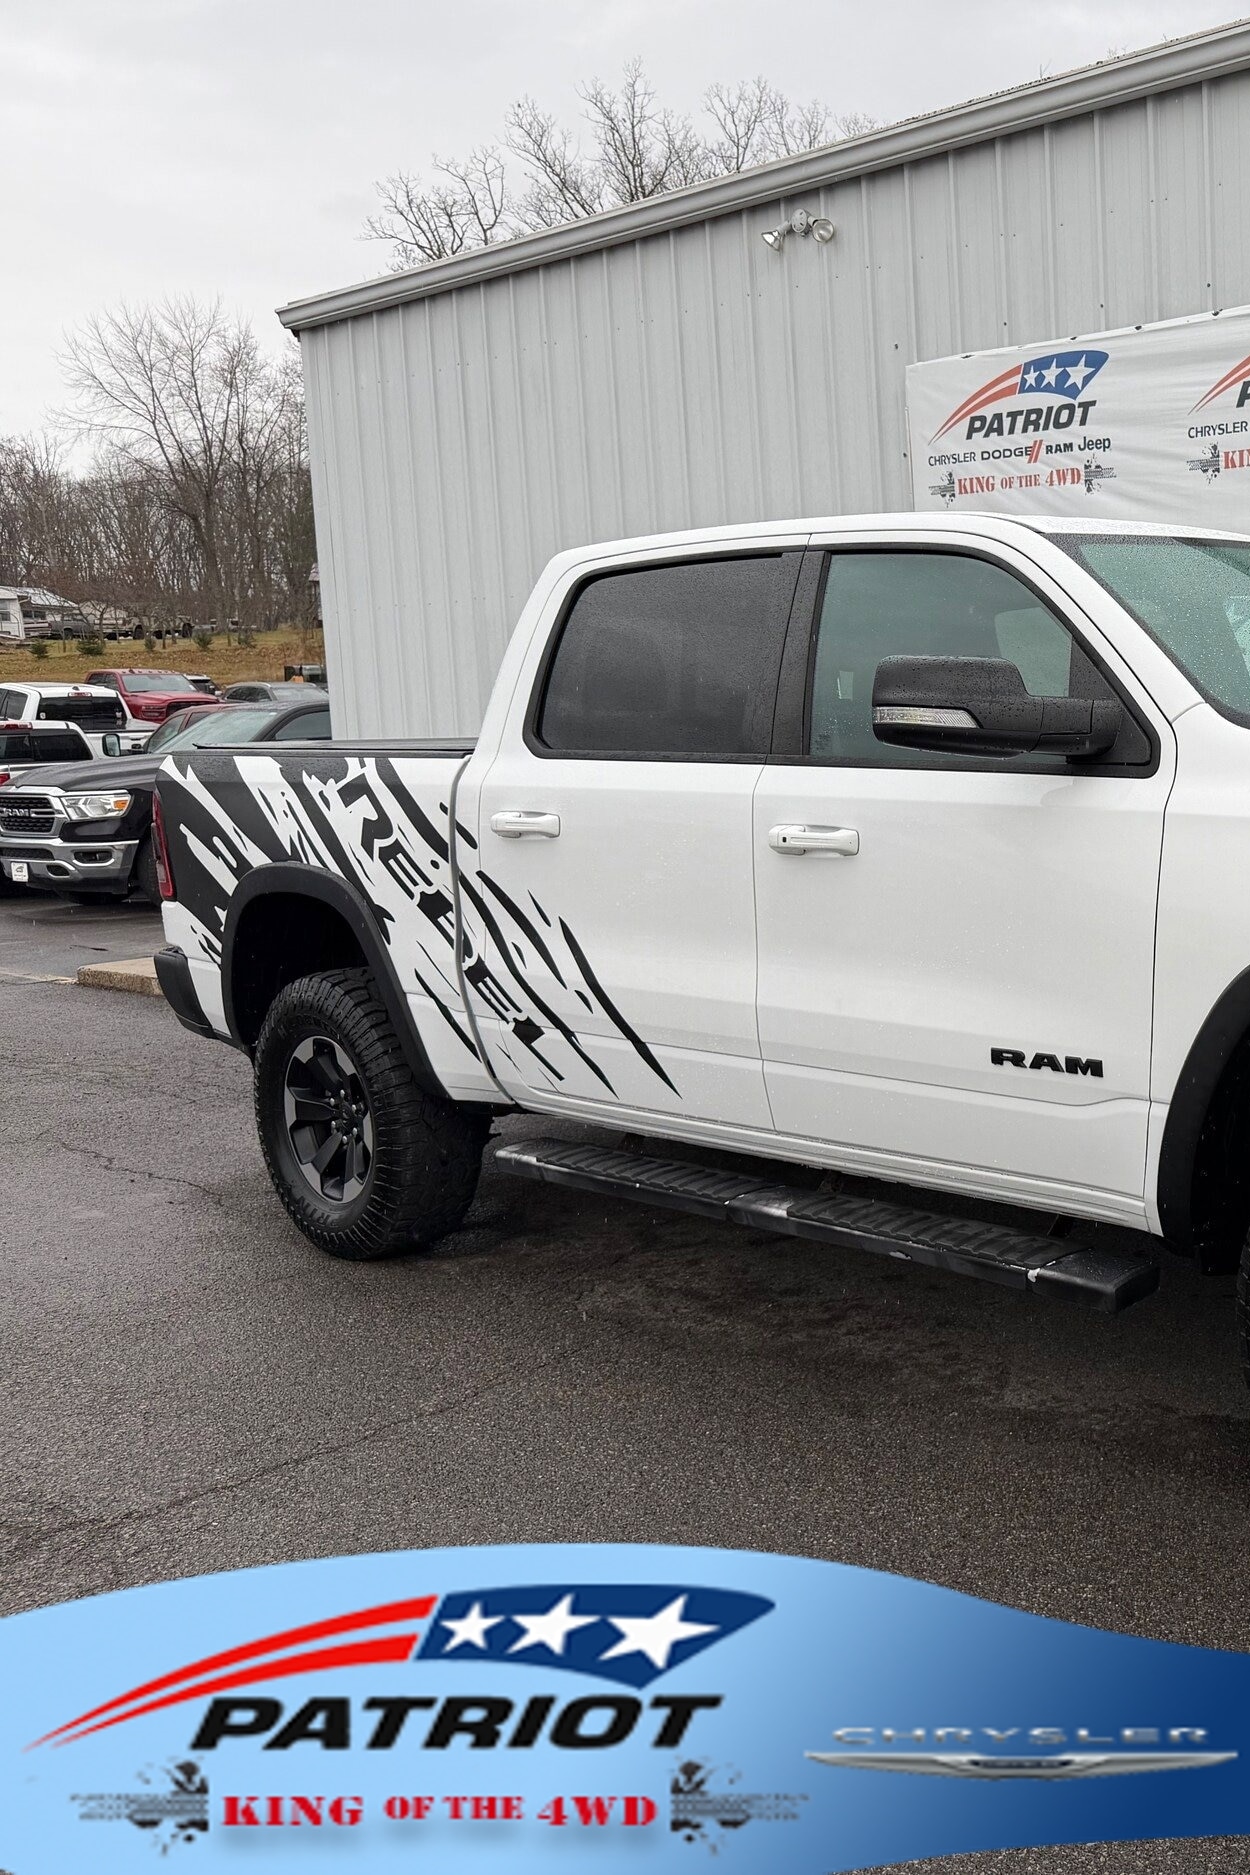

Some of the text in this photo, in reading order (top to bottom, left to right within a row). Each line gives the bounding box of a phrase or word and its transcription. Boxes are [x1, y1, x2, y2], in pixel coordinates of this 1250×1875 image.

[966, 400, 1097, 440] PATRIOT
[1187, 420, 1249, 438] CHRYSLER
[928, 436, 1111, 466] CHRYSLER DODGE RAM Jeep
[957, 467, 1081, 495] KING OF THE 4WD
[991, 1047, 1103, 1077] RAM
